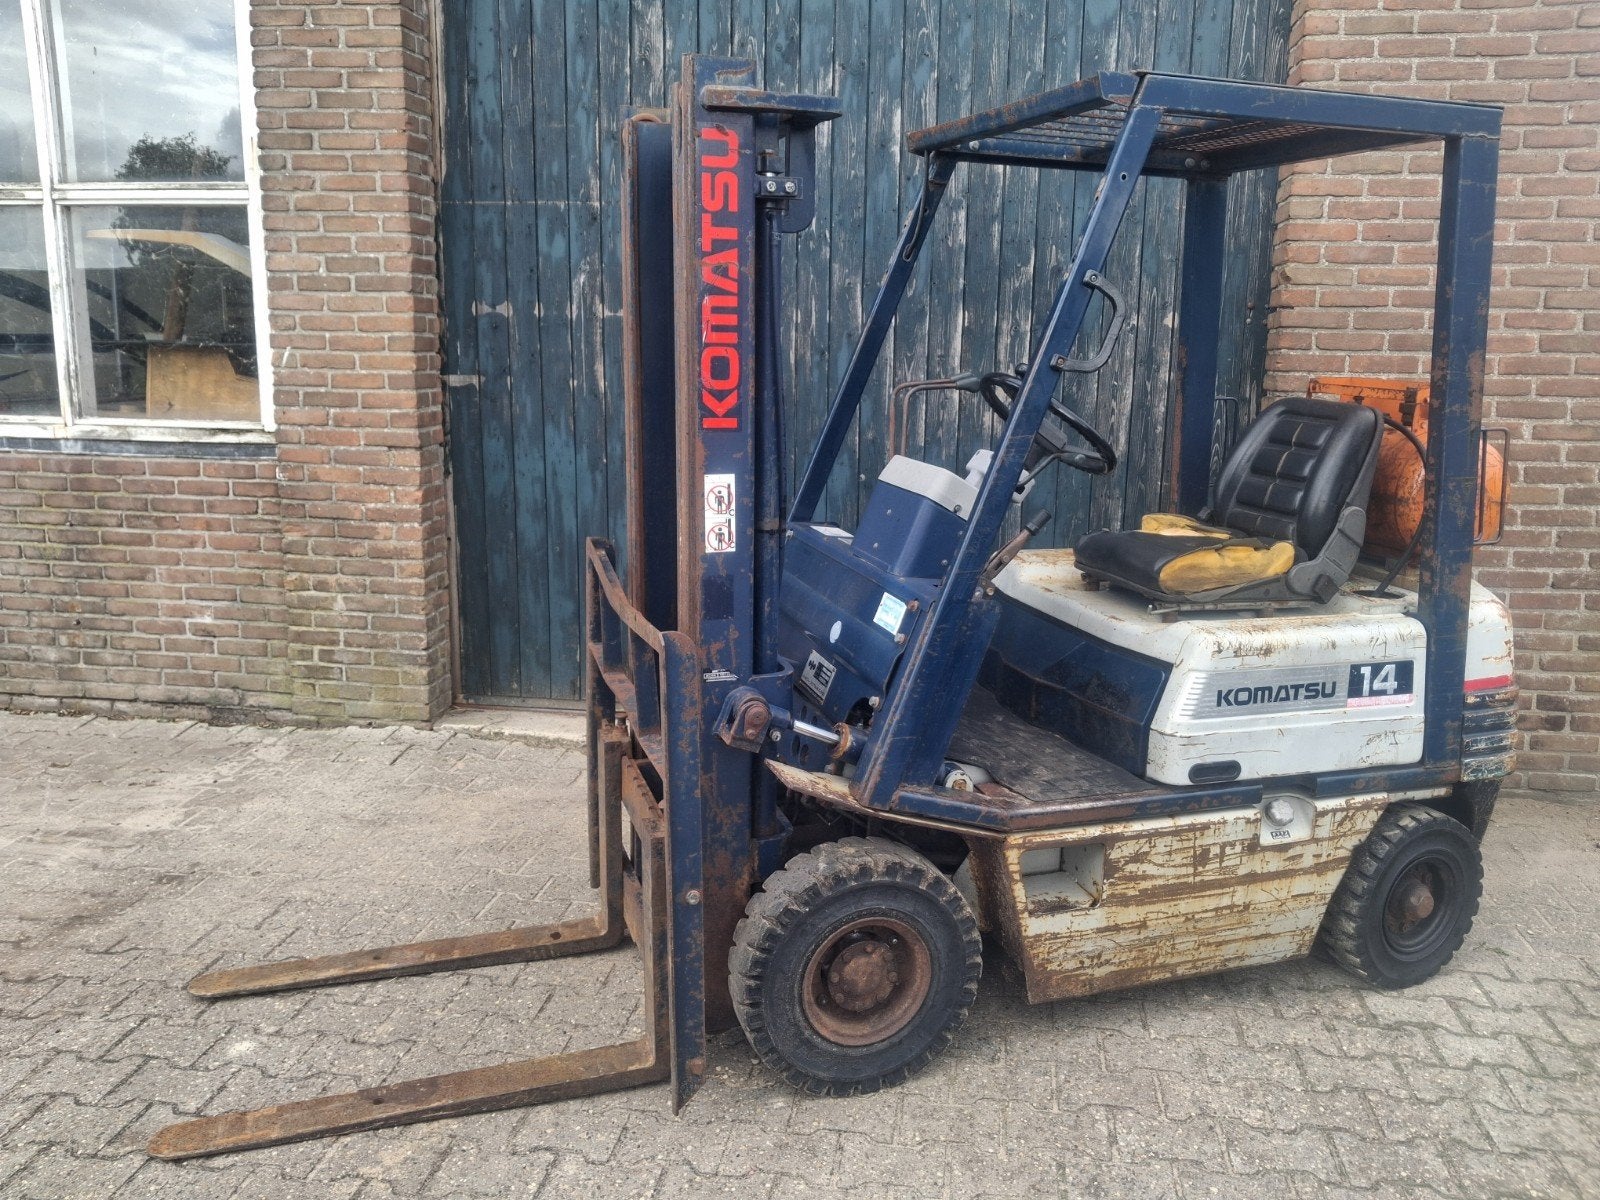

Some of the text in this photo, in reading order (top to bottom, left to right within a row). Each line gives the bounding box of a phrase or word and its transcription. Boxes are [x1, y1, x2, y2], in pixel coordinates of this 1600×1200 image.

[701, 127, 739, 428] KOMATSU
[1216, 681, 1337, 707] KOMATSU
[1360, 664, 1398, 697] 14
